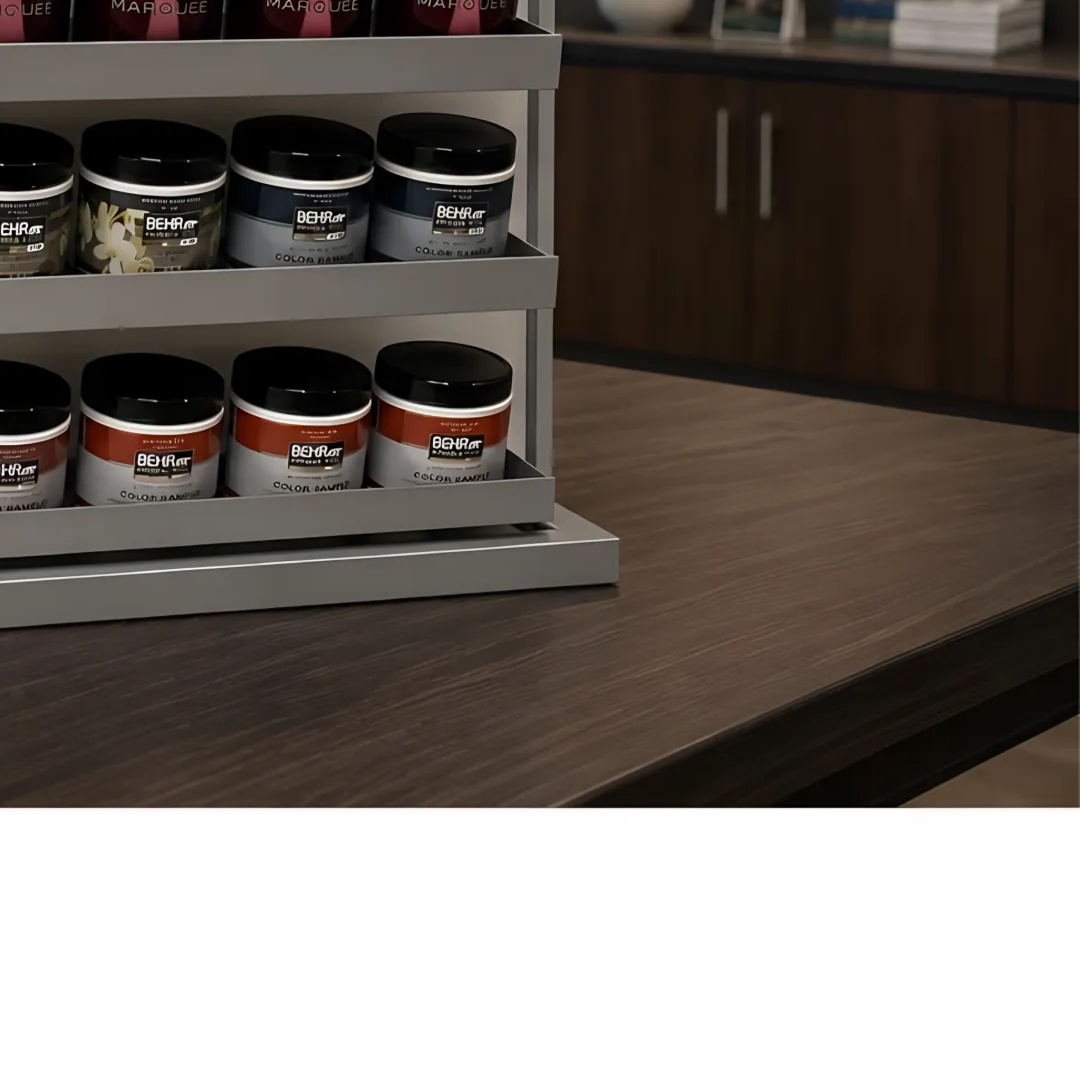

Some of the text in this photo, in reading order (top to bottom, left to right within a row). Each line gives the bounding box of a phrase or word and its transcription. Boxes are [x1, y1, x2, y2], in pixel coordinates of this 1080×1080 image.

[436, 205, 473, 220] BEHR
[146, 216, 183, 230] BEHR
[291, 444, 329, 458] BEHR
[137, 453, 176, 467] BEHR
